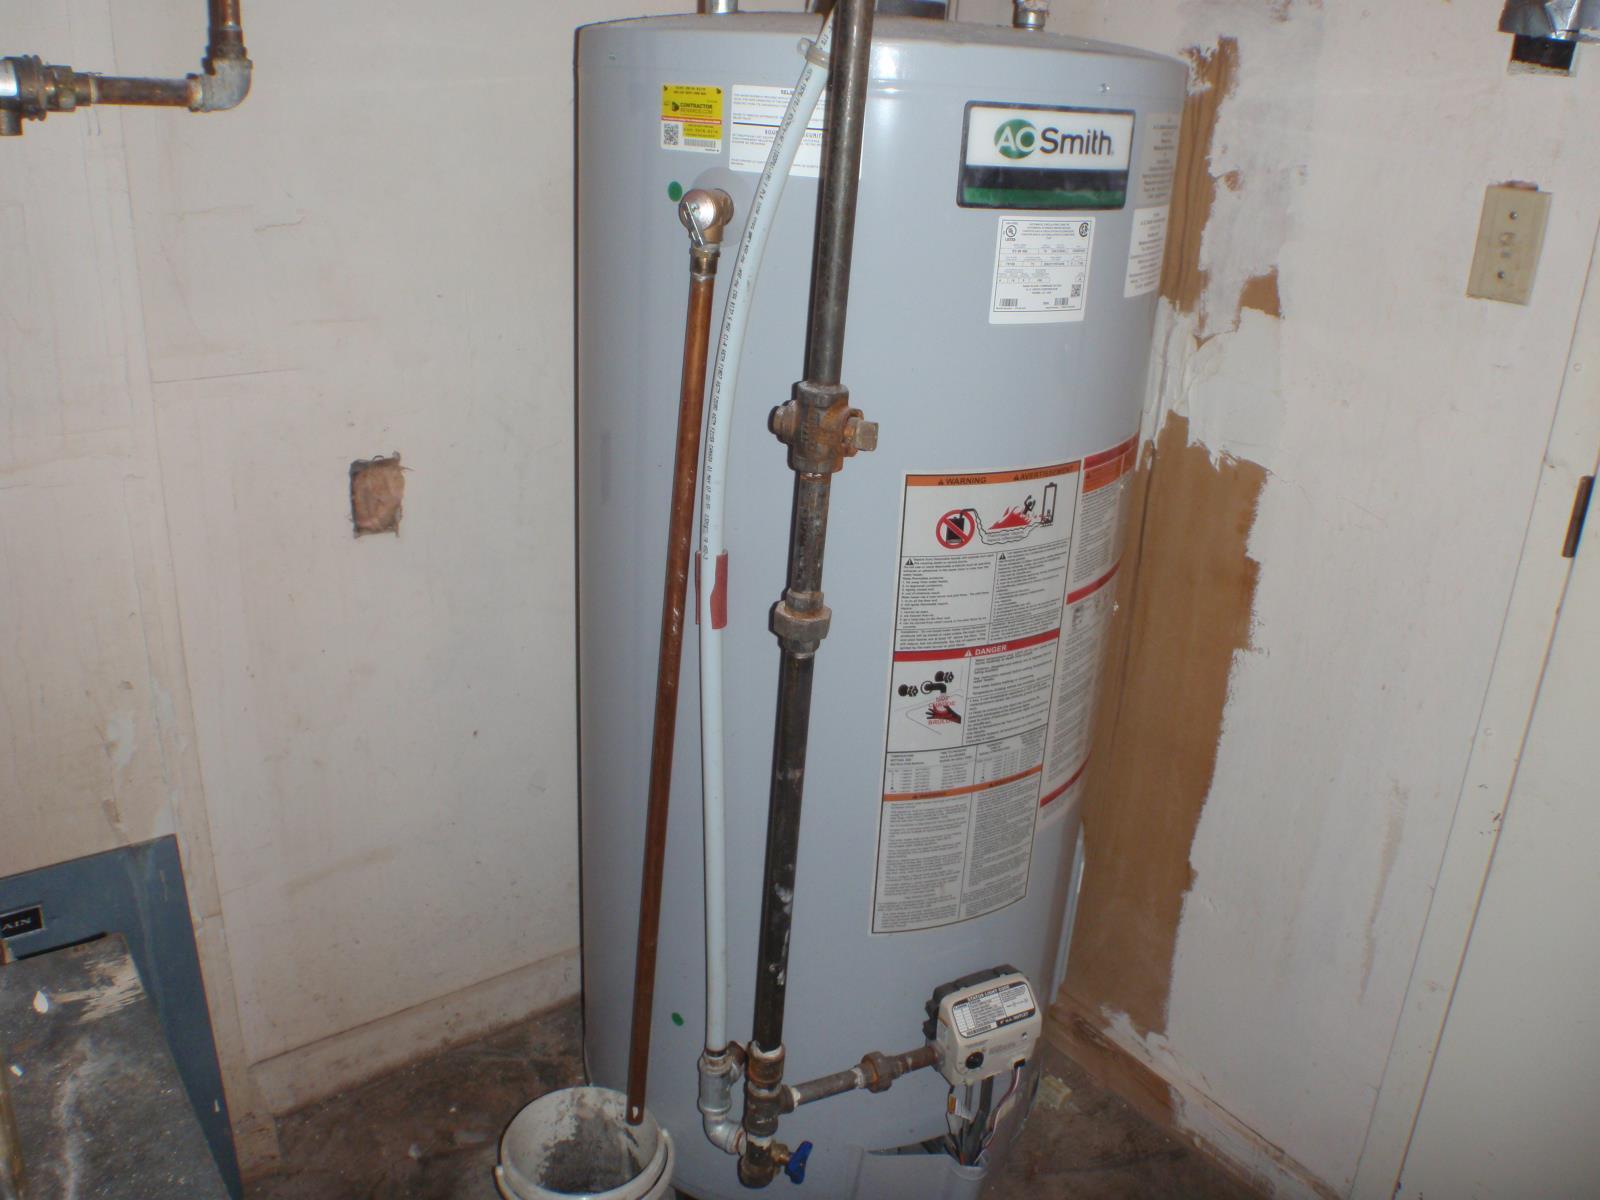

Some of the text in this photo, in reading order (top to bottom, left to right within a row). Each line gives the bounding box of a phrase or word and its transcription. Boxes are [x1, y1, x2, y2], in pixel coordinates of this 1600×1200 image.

[1040, 126, 1112, 156] Smith
[945, 476, 987, 486] WARNING
[974, 644, 1008, 656] DANGER
